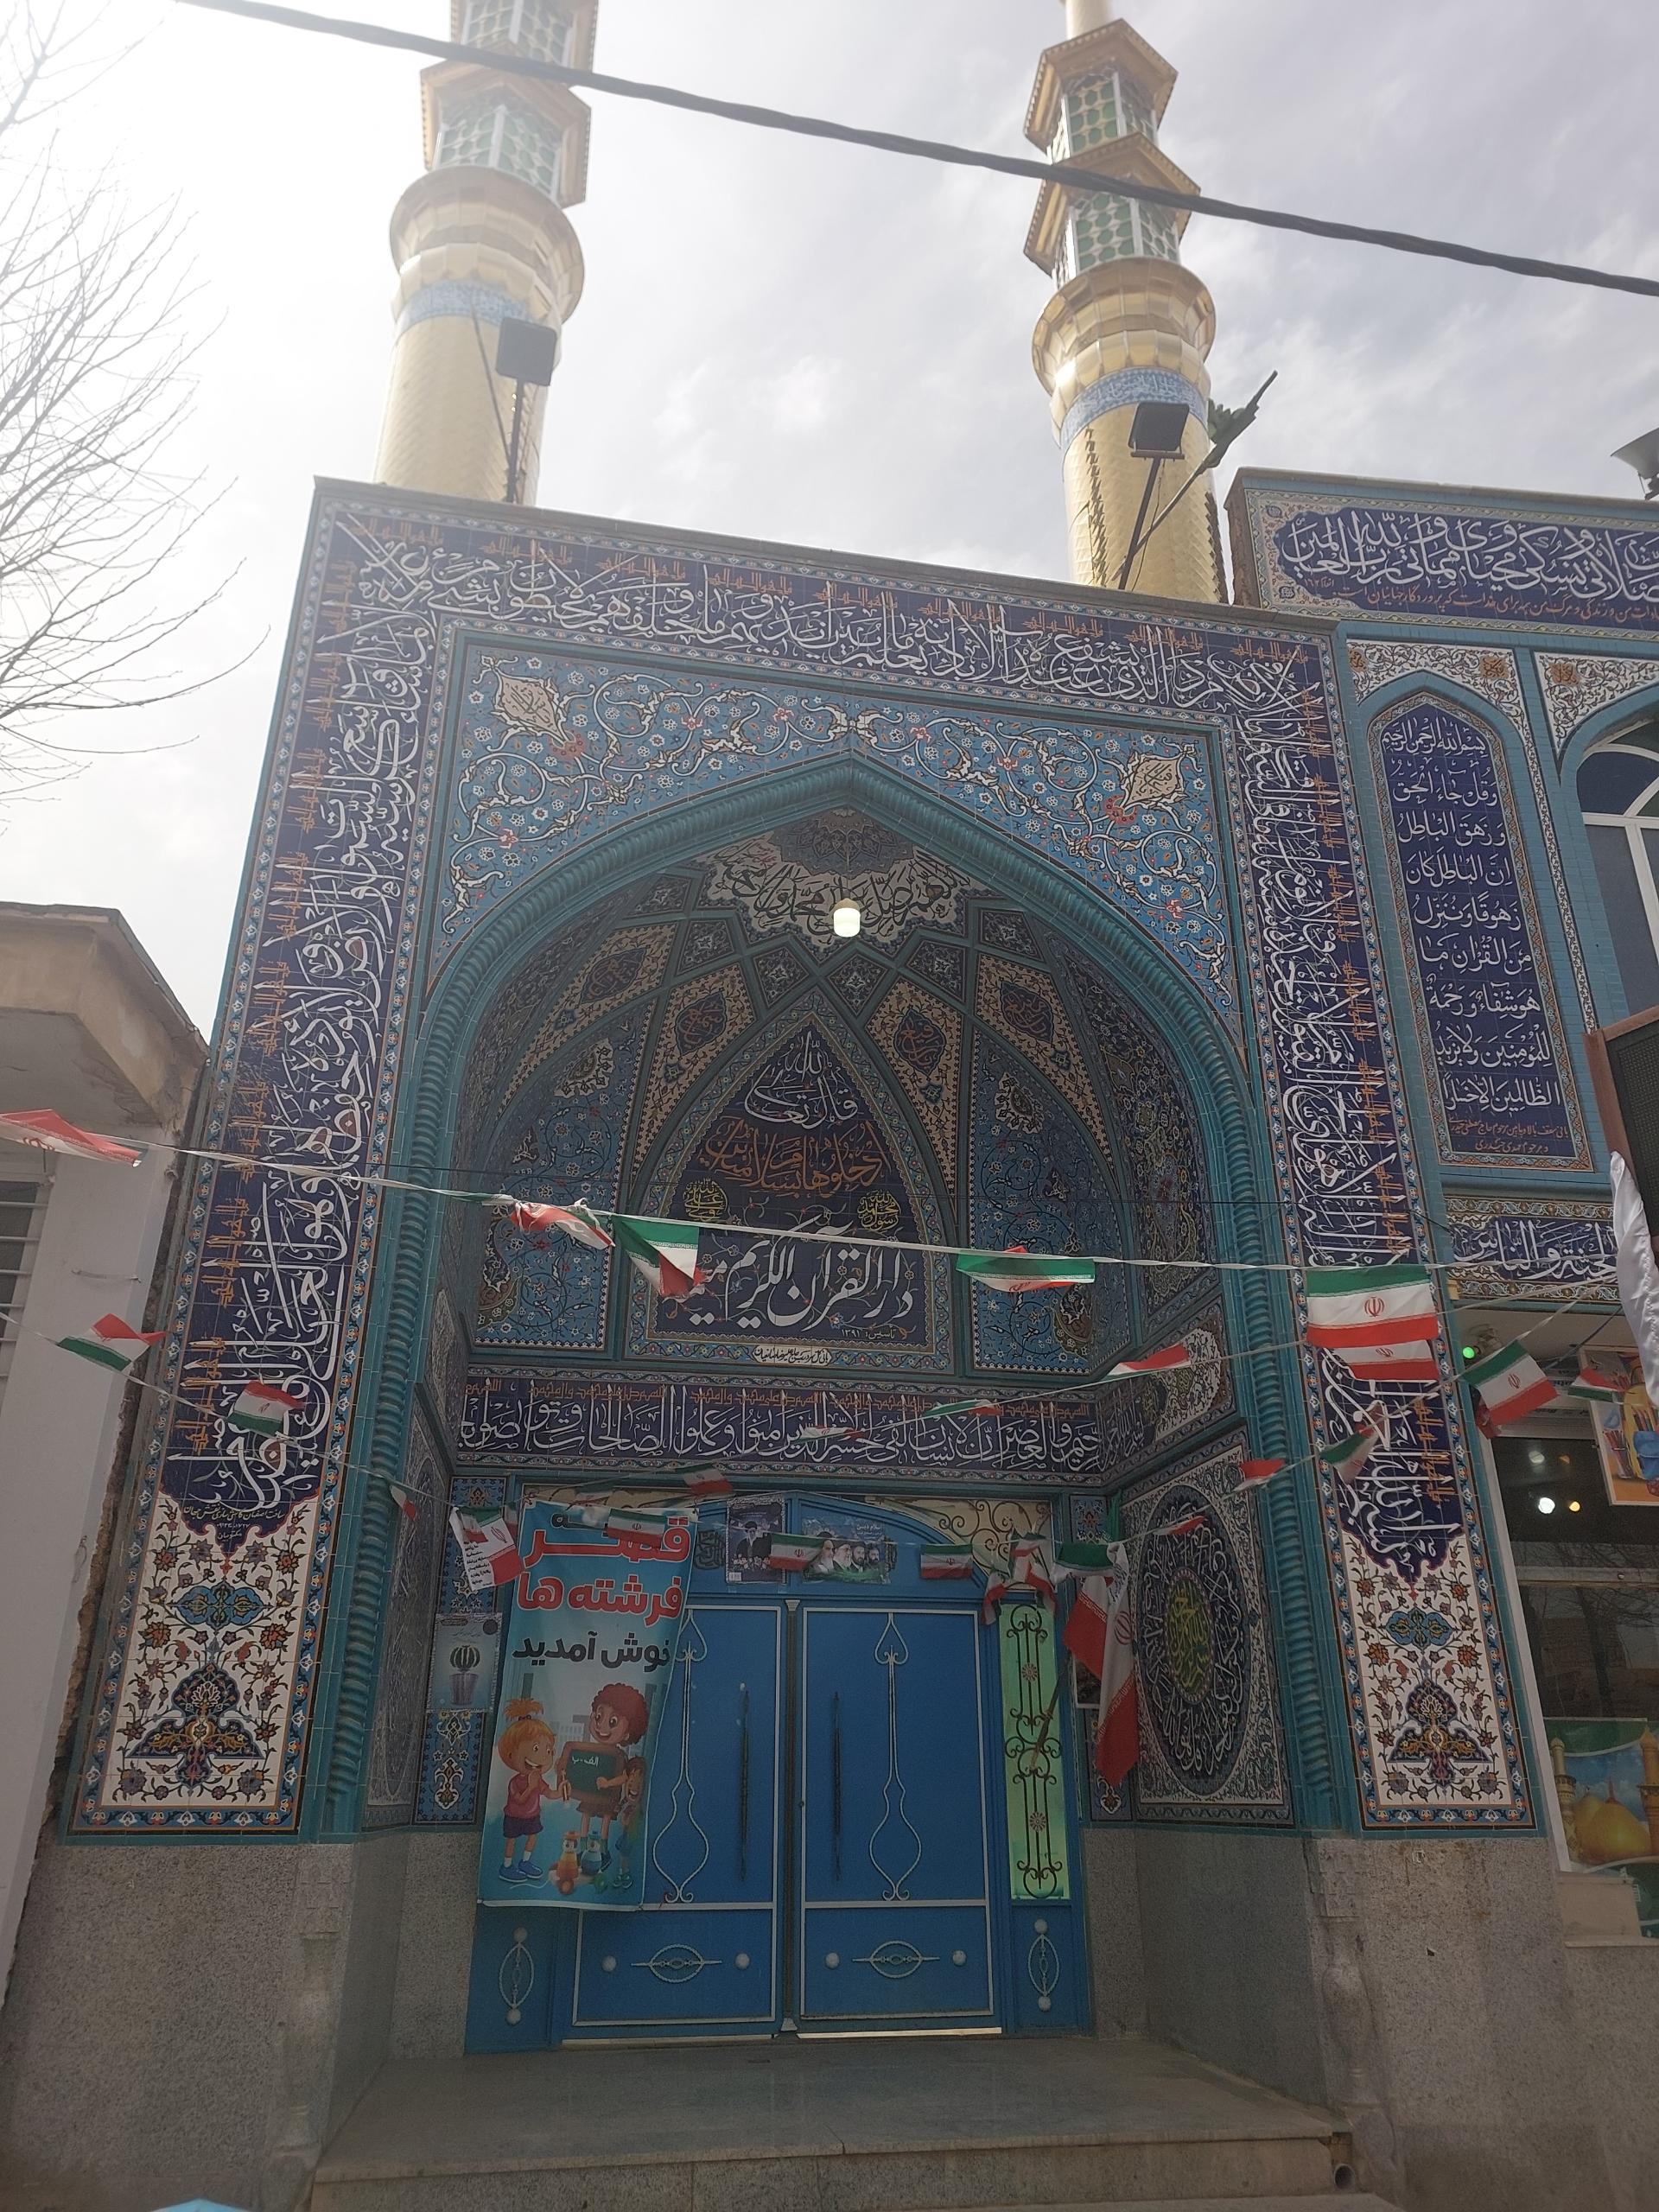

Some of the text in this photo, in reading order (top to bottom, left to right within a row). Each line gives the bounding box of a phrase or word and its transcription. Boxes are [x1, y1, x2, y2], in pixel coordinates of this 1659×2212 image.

[518, 1571, 683, 1627] فرشته ها
[512, 1630, 598, 1667] آمدید
